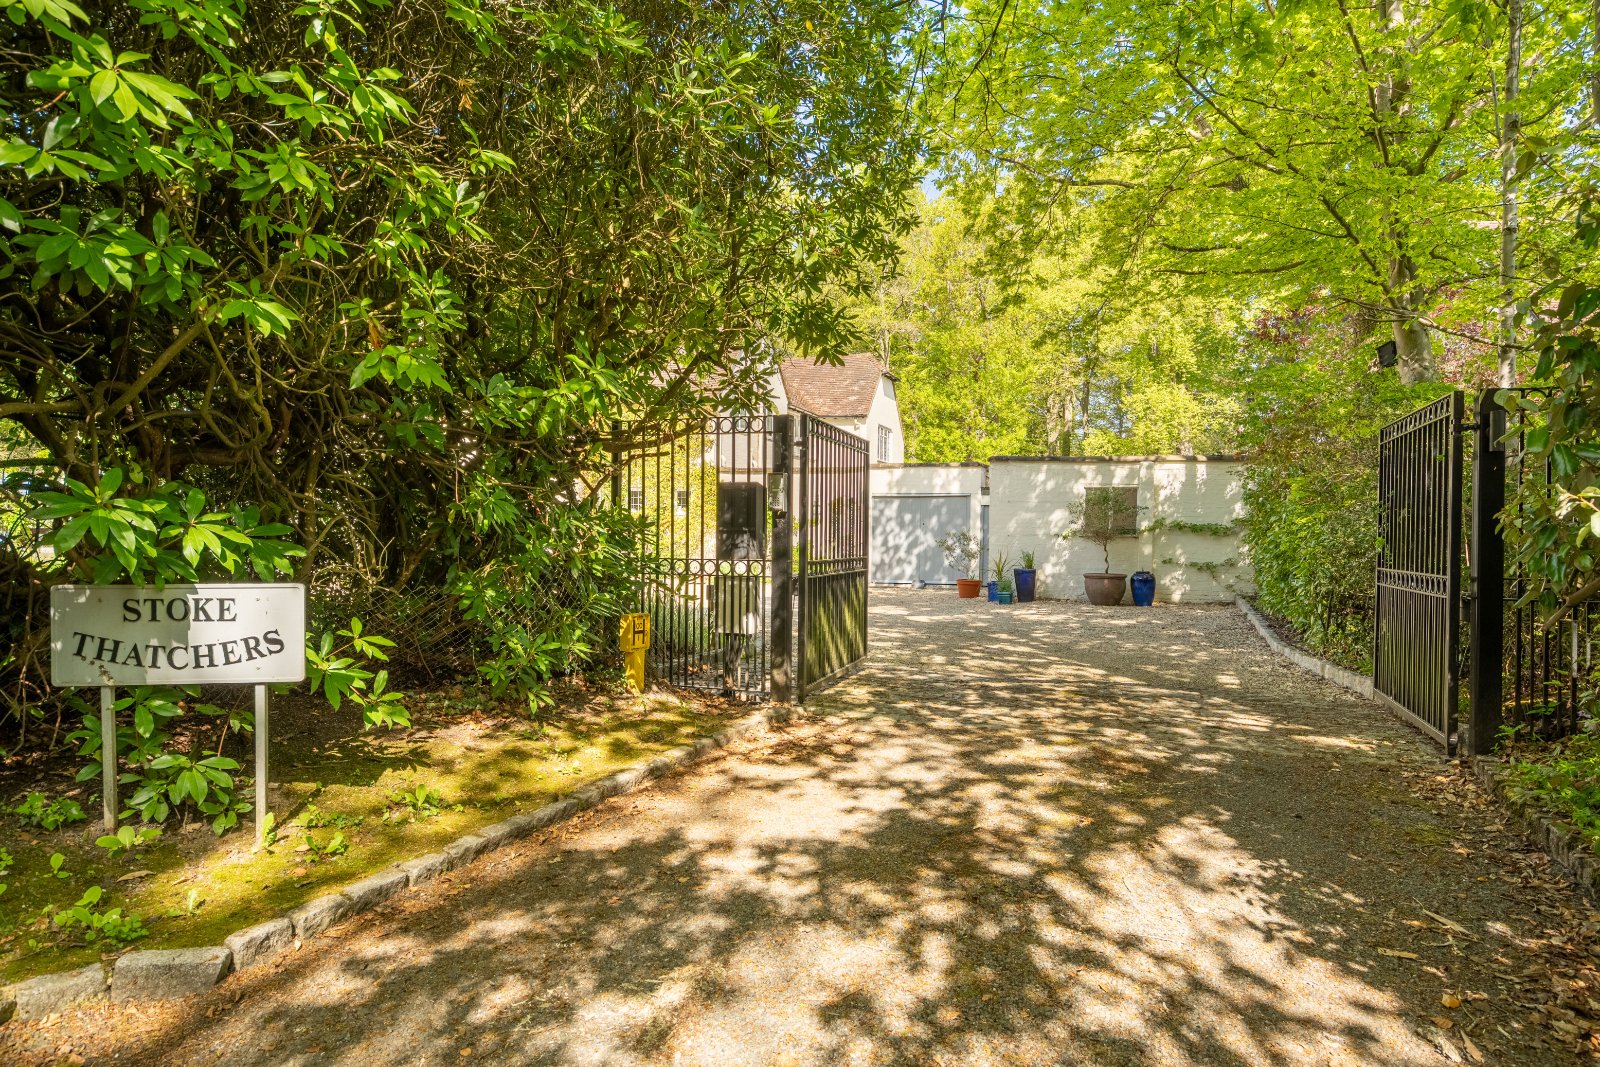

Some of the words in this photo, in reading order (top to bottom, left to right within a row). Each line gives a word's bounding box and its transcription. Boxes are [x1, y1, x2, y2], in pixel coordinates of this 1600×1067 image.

[122, 597, 238, 622] STOKE
[632, 618, 646, 646] H
[72, 629, 285, 671] THATCHERS
